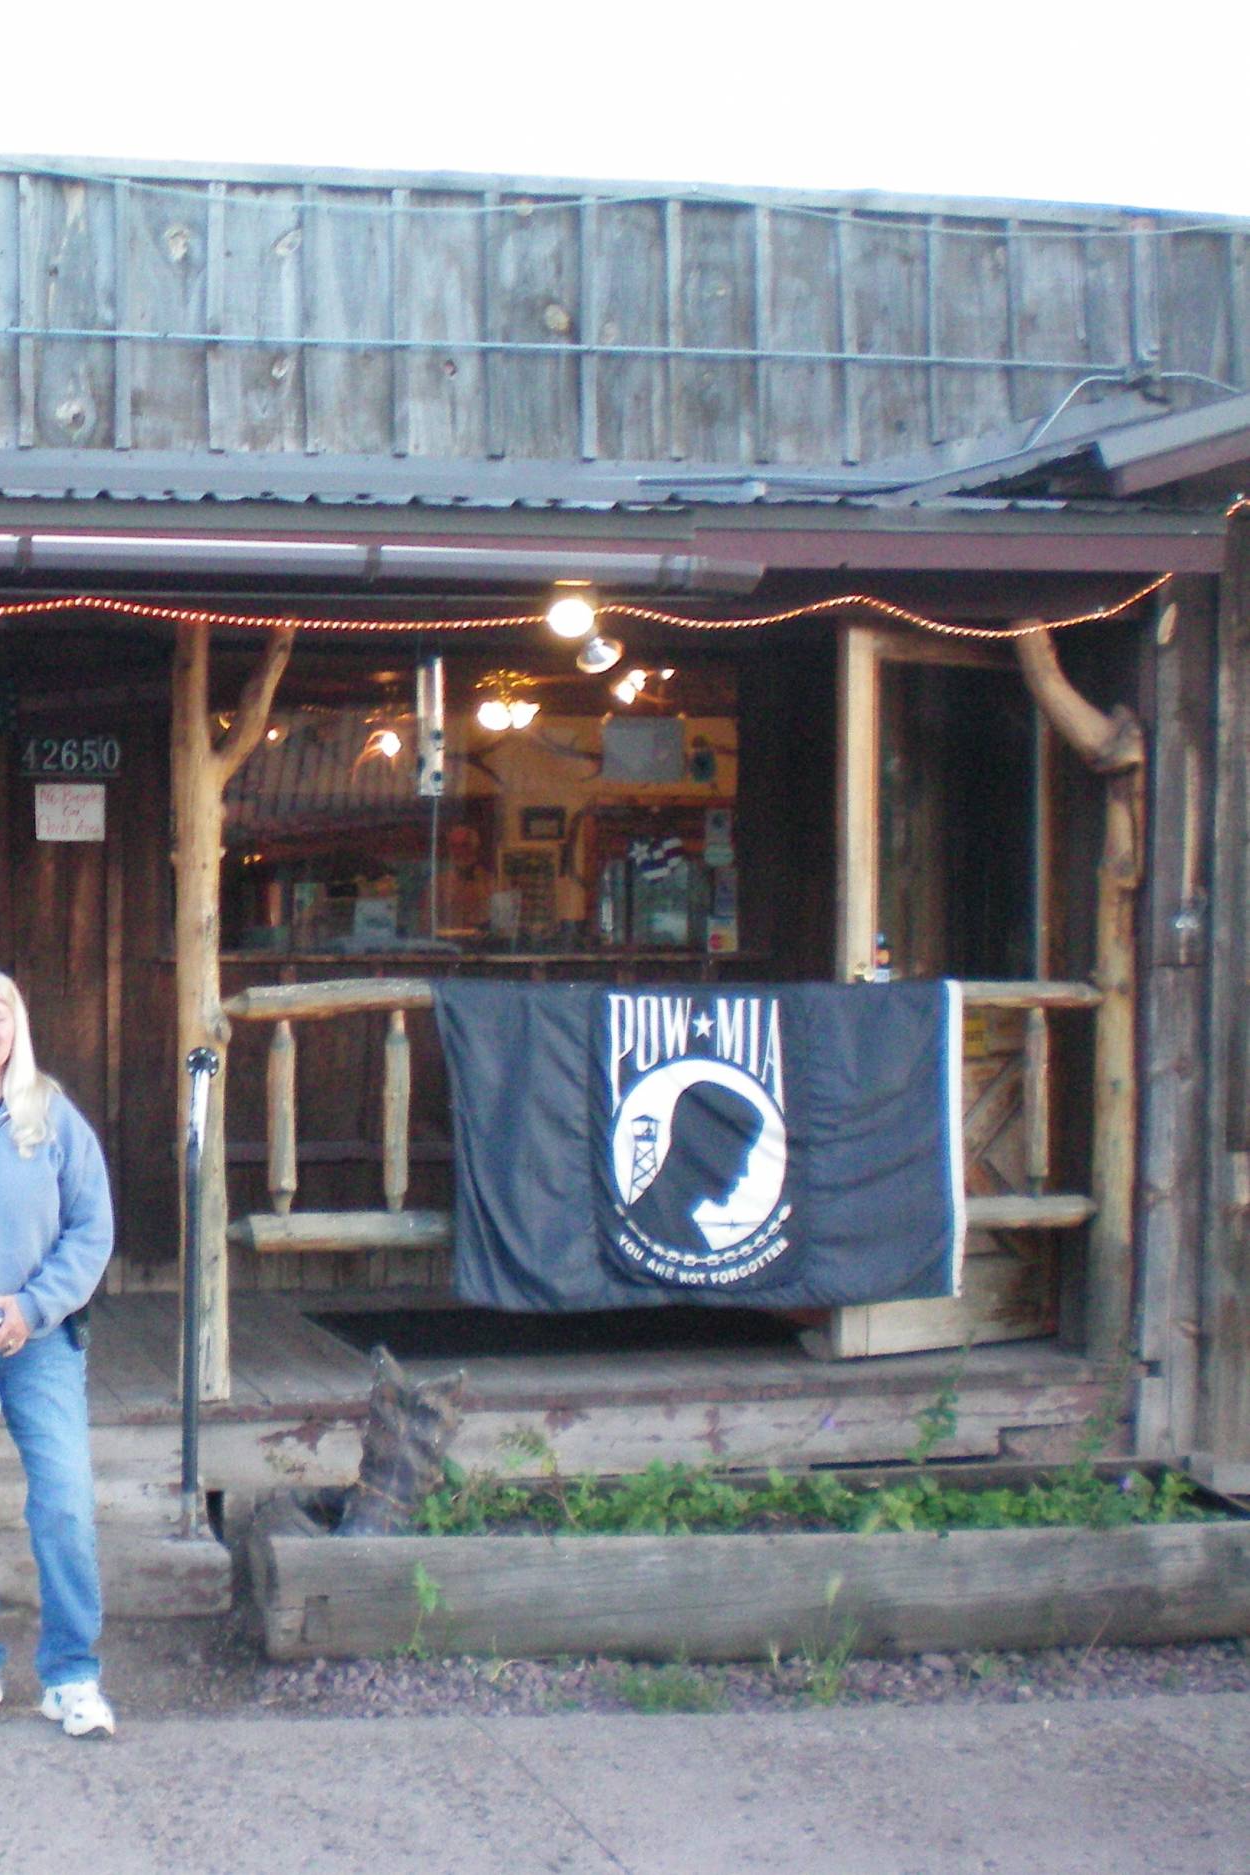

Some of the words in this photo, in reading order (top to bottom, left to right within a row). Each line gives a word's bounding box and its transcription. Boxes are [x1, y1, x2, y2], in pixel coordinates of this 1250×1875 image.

[22, 738, 120, 770] 42650
[608, 993, 692, 1118] POW
[716, 997, 786, 1114] MIA
[618, 1233, 644, 1261] YOU
[646, 1257, 676, 1280] ARE
[678, 1271, 706, 1284] NOT
[709, 1237, 790, 1285] FORGOTTEN
